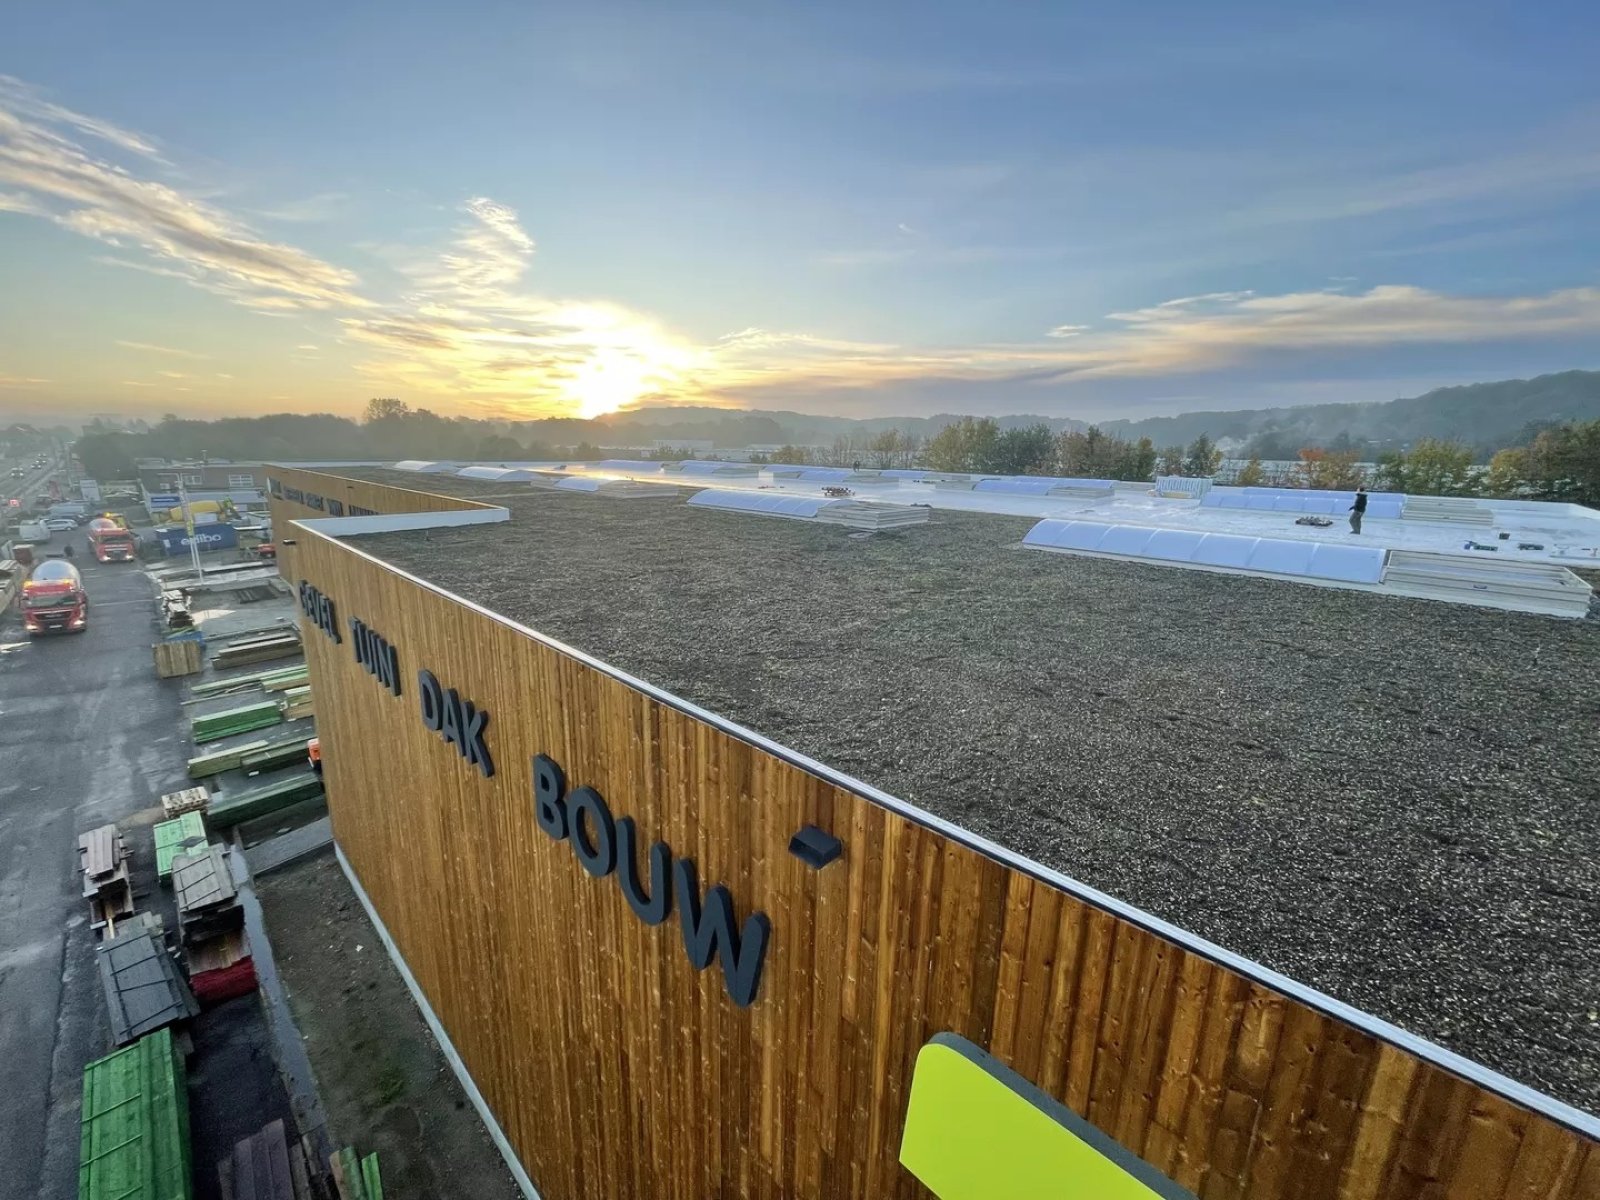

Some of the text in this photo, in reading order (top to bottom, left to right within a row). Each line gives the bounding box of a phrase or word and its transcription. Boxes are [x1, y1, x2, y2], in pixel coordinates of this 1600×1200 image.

[348, 616, 402, 697] TUIN
[418, 668, 495, 778] DAK
[533, 753, 771, 1008] BOUW
